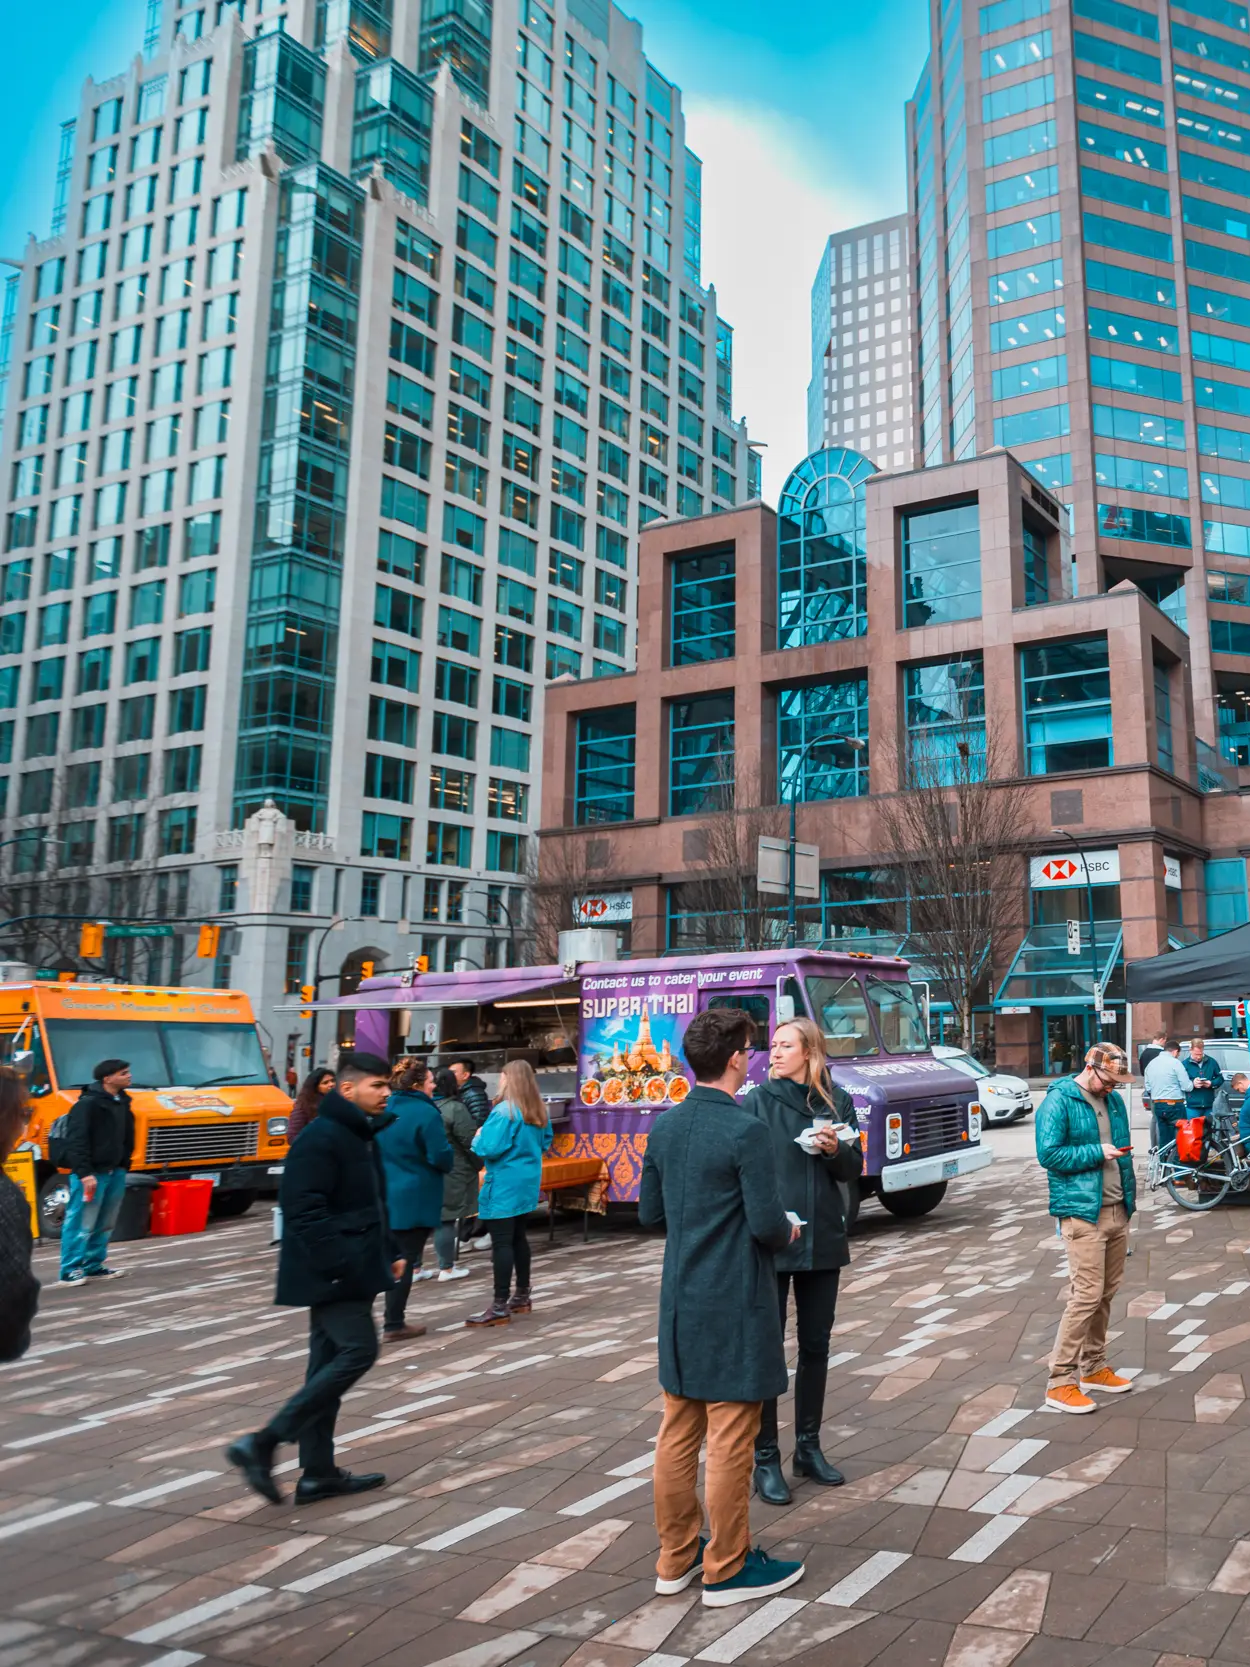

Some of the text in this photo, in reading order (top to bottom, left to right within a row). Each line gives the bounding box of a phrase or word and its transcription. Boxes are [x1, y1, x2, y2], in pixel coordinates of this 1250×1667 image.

[1080, 861, 1110, 873] HSBC
[609, 900, 631, 910] HSBC
[582, 967, 764, 991] Contact us to cater your event
[582, 993, 694, 1019] SUPER THAI
